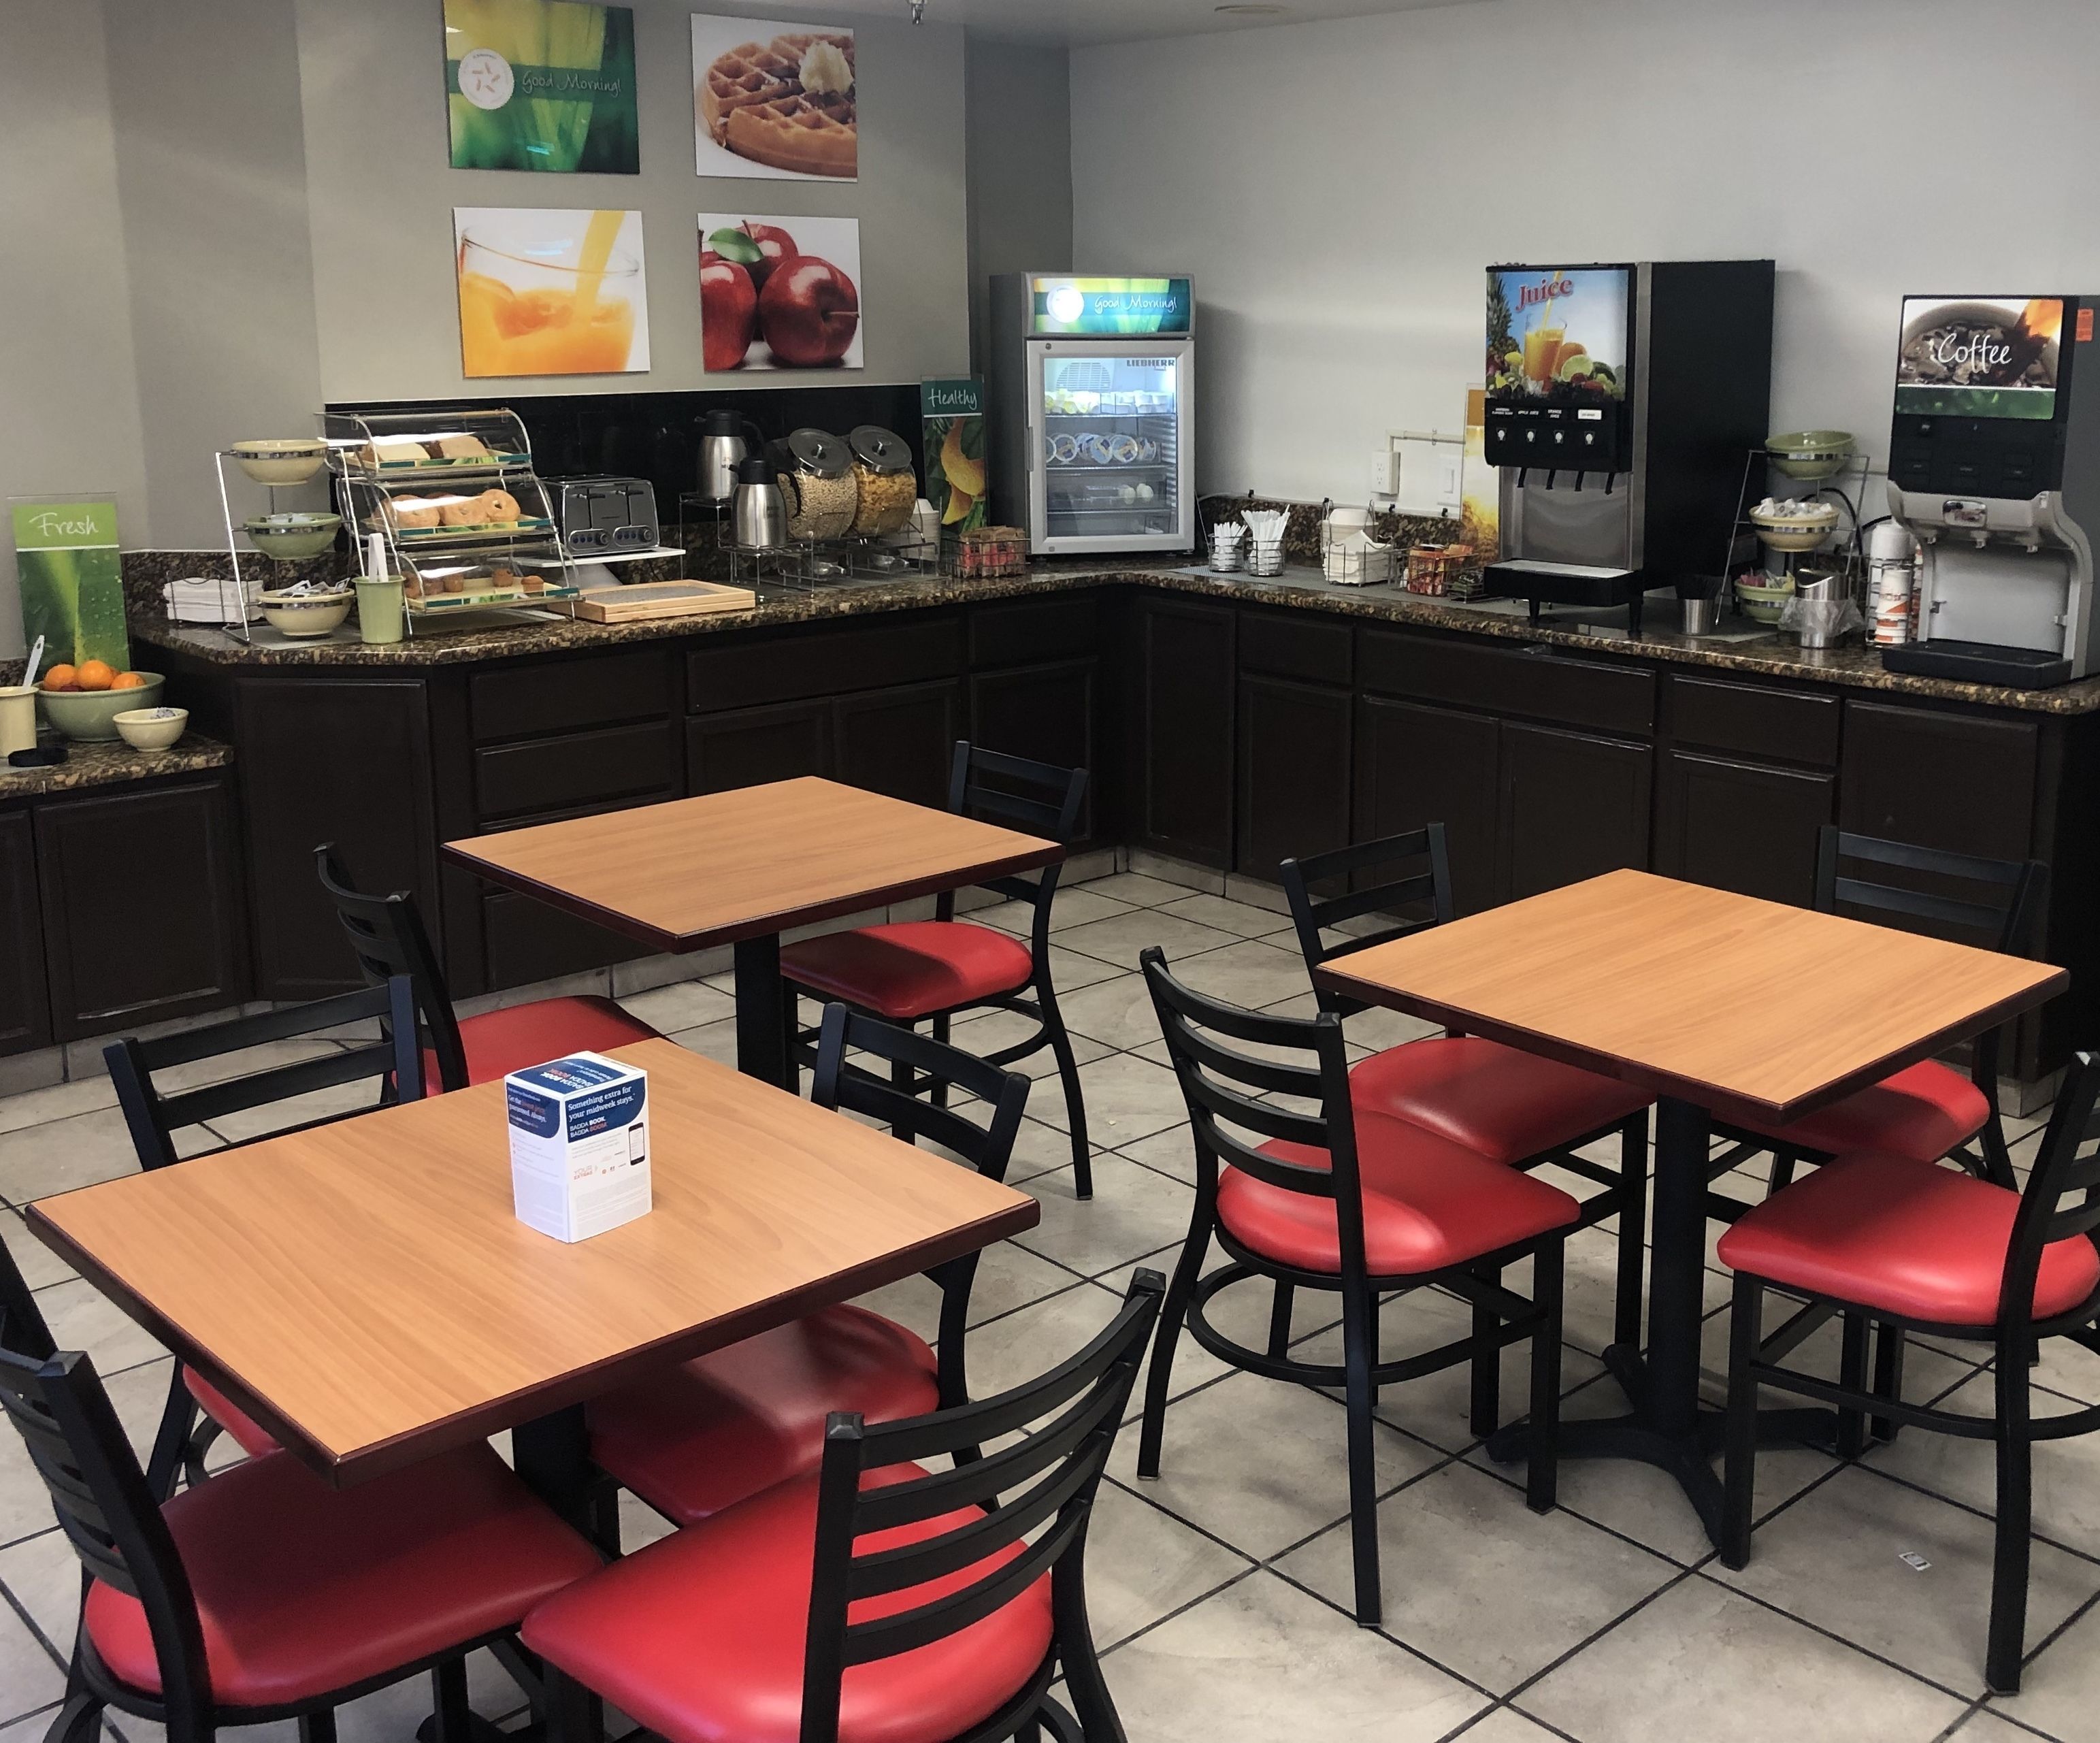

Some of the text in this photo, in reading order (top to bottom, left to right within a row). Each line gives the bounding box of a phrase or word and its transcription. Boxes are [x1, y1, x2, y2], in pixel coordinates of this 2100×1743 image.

[523, 70, 621, 98] Good Morning!
[1094, 295, 1177, 314] Good Morning!
[1515, 279, 1573, 312] Juice
[1937, 333, 2012, 374] Coffee
[928, 388, 977, 410] Healthy
[29, 512, 99, 537] Fresh
[568, 1095, 604, 1111] Something
[604, 1090, 621, 1100] extra
[568, 1111, 585, 1122] your
[586, 1100, 617, 1115] midweek
